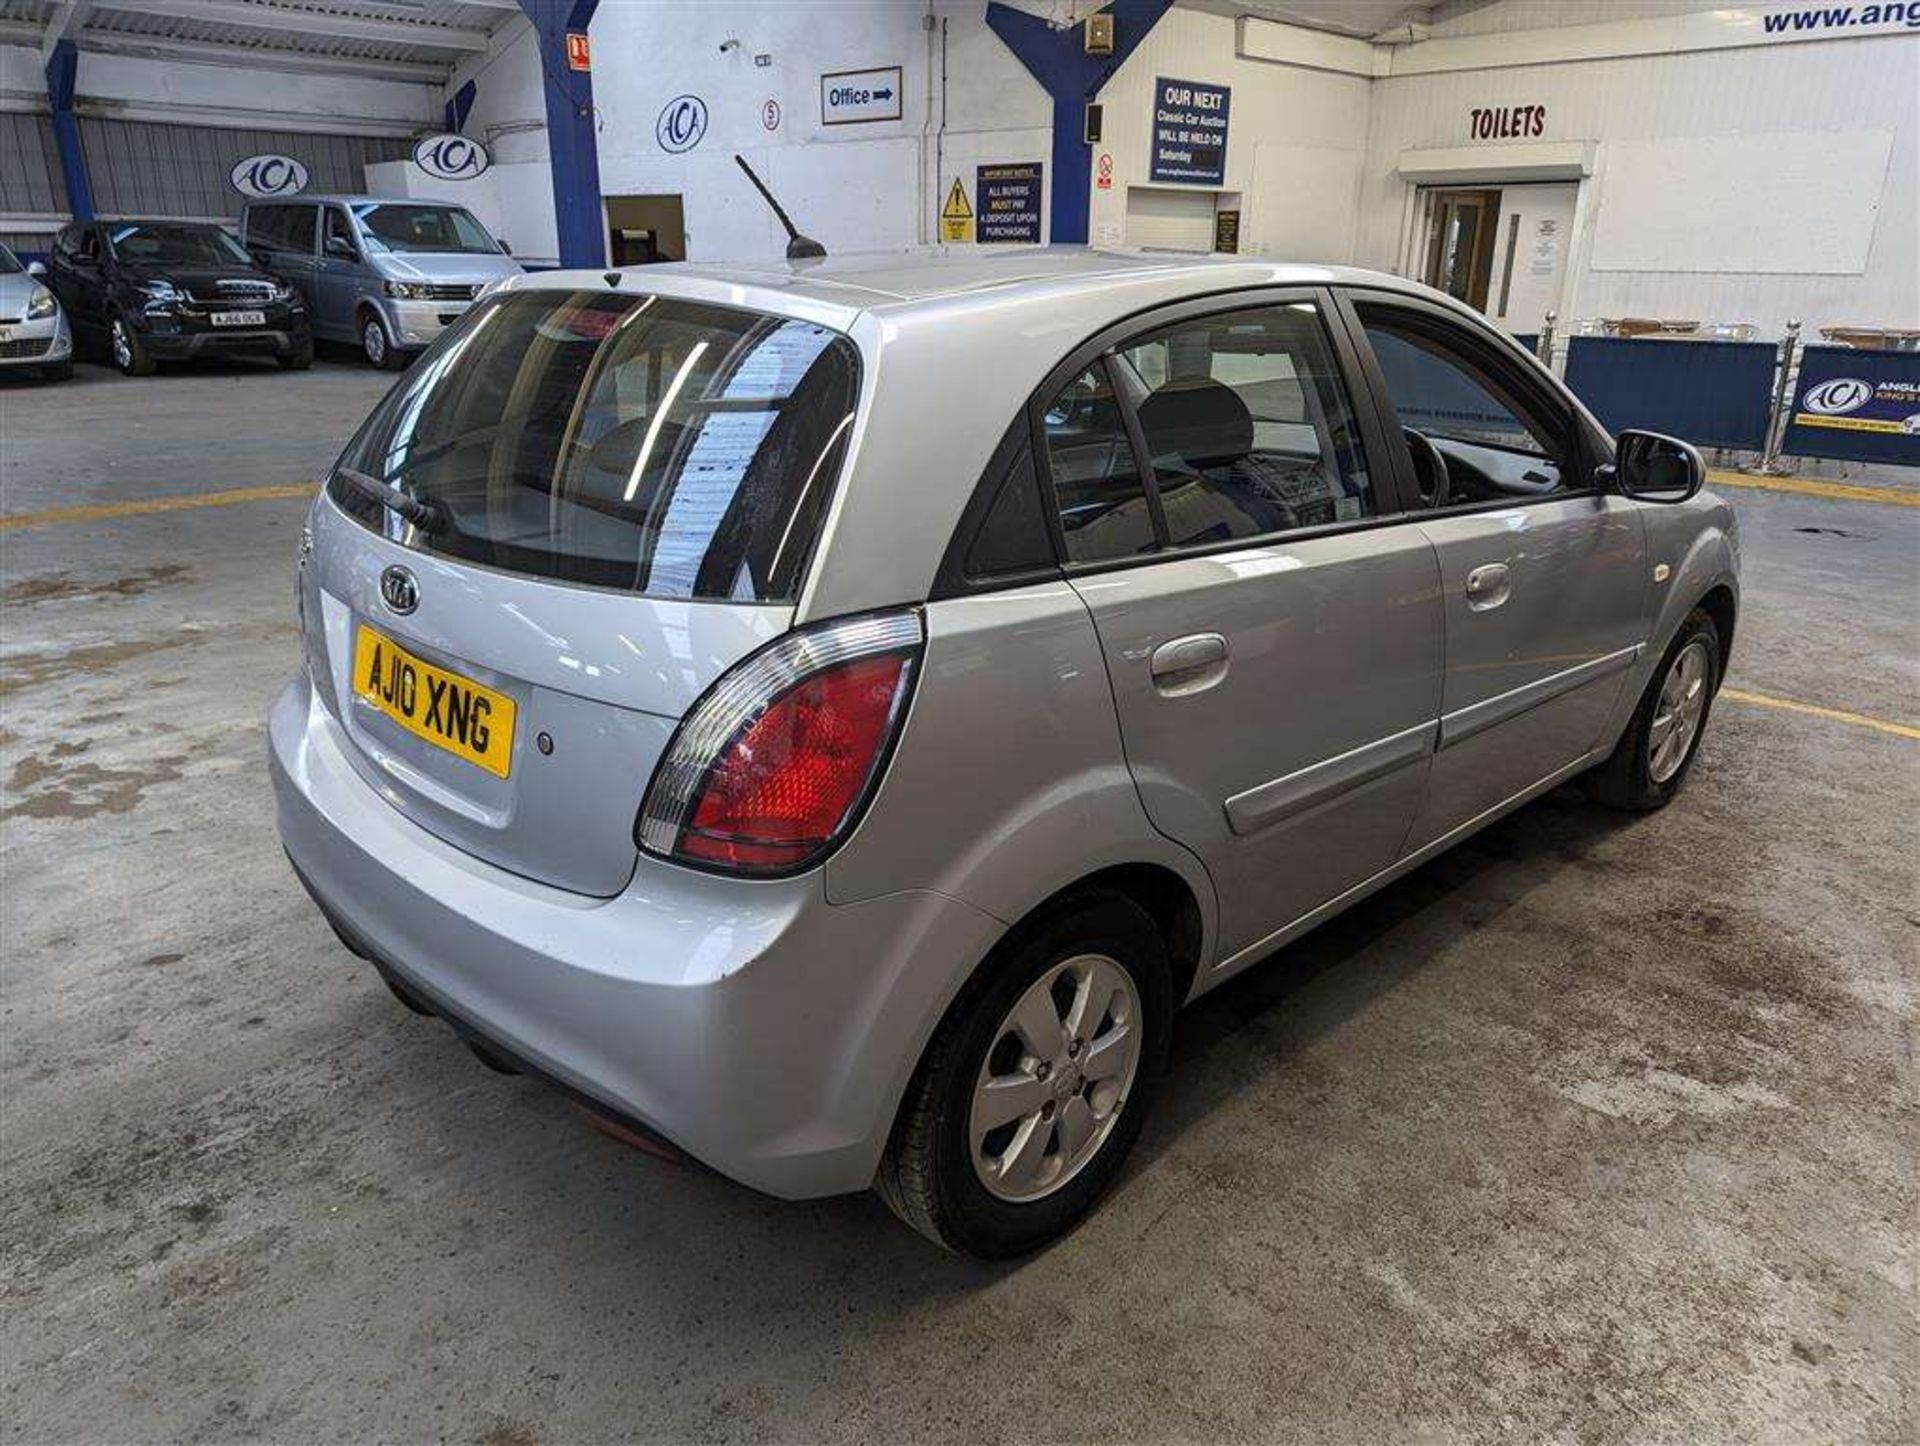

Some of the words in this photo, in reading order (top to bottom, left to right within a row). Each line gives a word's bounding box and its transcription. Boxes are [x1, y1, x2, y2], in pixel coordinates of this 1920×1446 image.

[829, 88, 870, 107] Office
[1165, 87, 1191, 106] OUR
[1193, 91, 1223, 109] NEXT
[767, 104, 775, 120] 5
[1157, 109, 1184, 123] Classic
[1185, 113, 1199, 125] Car
[1200, 116, 1226, 127] Auction
[664, 102, 699, 145] ACA
[1470, 105, 1545, 139] TOILETS
[1158, 129, 1177, 142] WILL
[1178, 131, 1189, 143] BE
[1190, 133, 1210, 145] HELD
[1211, 135, 1223, 146] ON
[423, 139, 479, 173] ACA
[1159, 148, 1192, 164] Saturday
[237, 158, 300, 194] ACA
[987, 187, 1001, 197] ALL
[1002, 185, 1030, 197] BUYERS
[990, 199, 1011, 210] MUST
[1012, 199, 1026, 210] PAY
[987, 213, 1015, 223] DEPOSIT
[1016, 212, 1038, 223] UPON
[985, 226, 1031, 237] PURCHASING
[1808, 382, 1867, 410] ACA
[384, 574, 411, 607] KIA
[368, 642, 417, 719] AJ10
[424, 674, 492, 755] XNG
